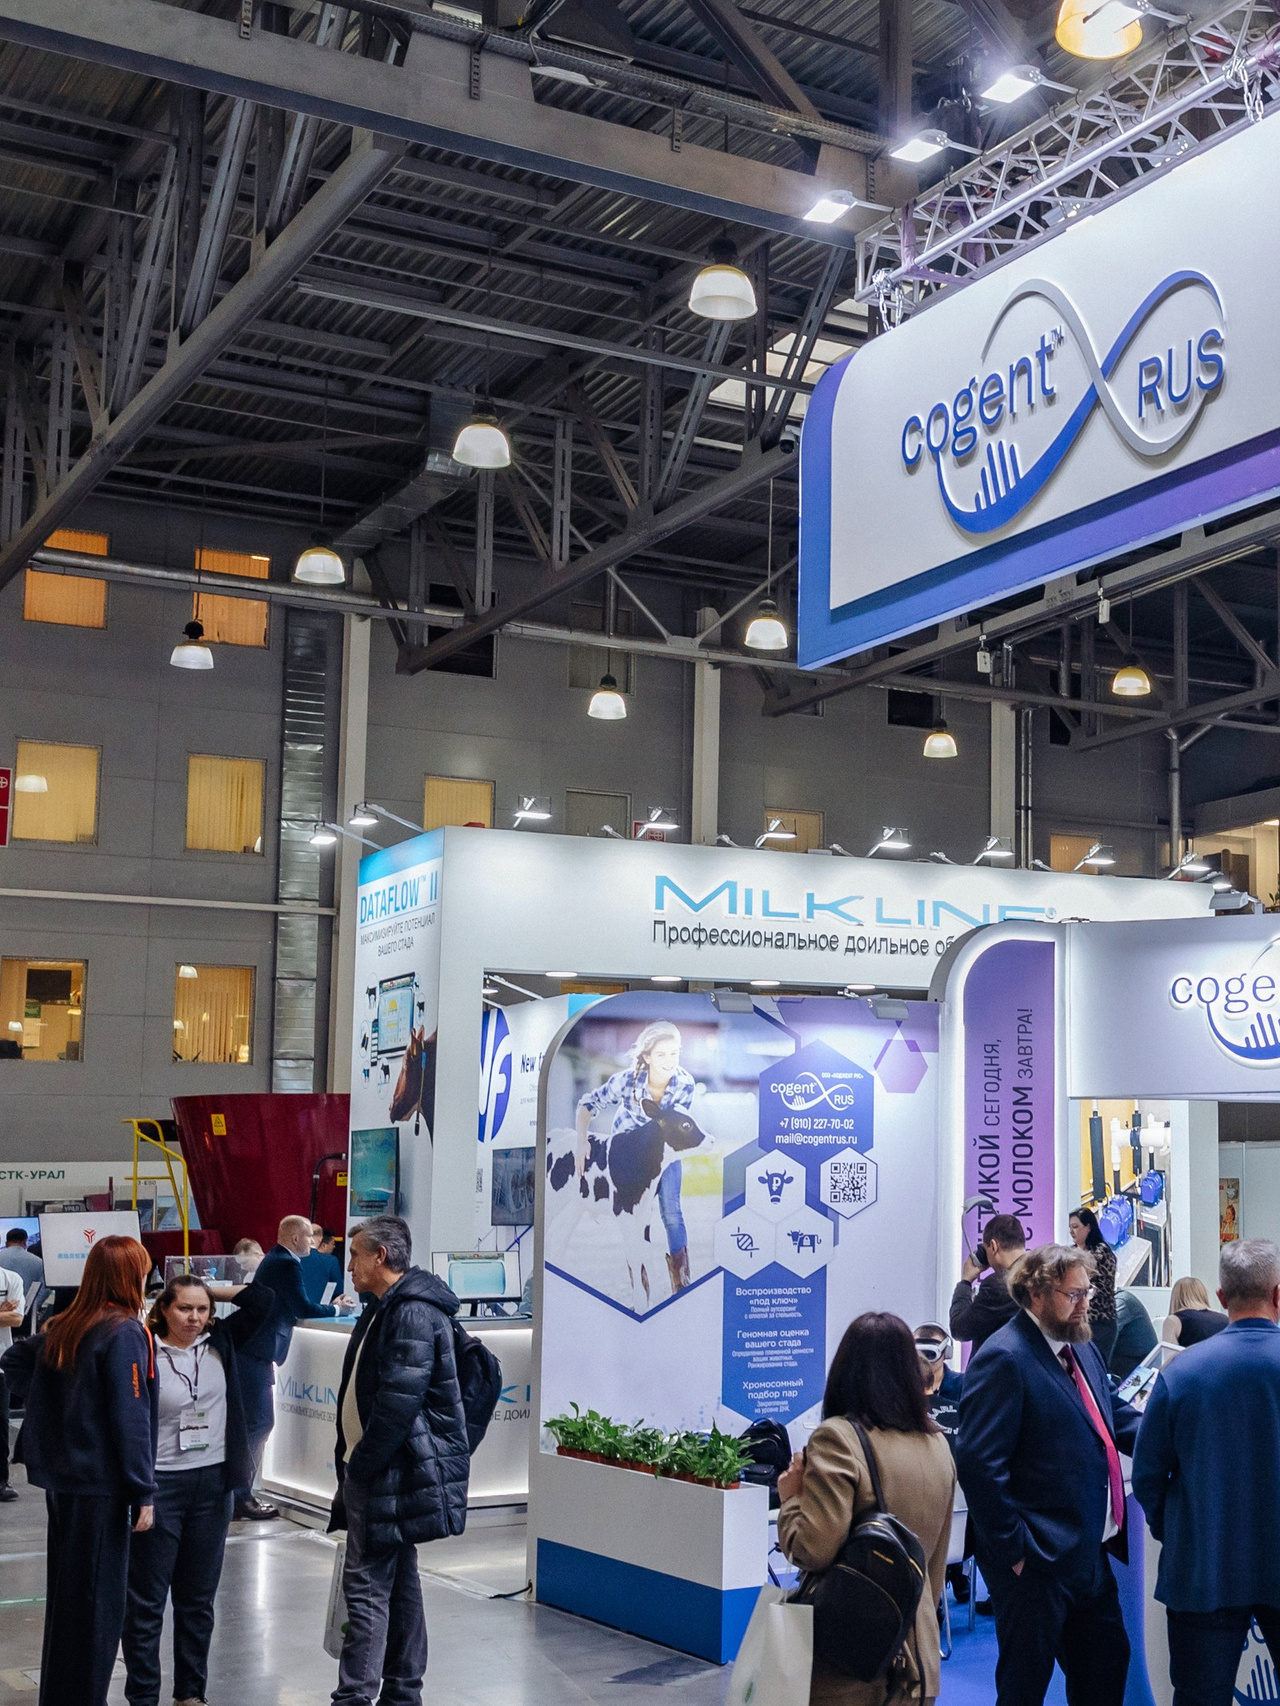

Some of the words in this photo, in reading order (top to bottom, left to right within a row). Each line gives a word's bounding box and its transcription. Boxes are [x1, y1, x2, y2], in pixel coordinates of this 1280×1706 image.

[1138, 329, 1224, 418] RUS
[398, 936, 414, 951] СТАДА
[653, 920, 840, 950] Профессиональное
[844, 935, 930, 957] доильное
[1017, 1007, 1034, 1080] ЗАВТРА!
[984, 1038, 1003, 1126] СЕГОДНЯ,
[834, 1094, 854, 1105] RUS
[780, 1118, 789, 1129] +7
[791, 1117, 811, 1131] (910)
[813, 1118, 855, 1130] 227-70-02
[775, 1132, 858, 1146] mail@cogentrus.ru
[1012, 1086, 1034, 1217] МОЛОКОМ
[973, 1134, 1001, 1242] ТИКОЙ
[735, 1287, 812, 1297] Воспроизводство
[749, 1298, 770, 1307] «под
[772, 1297, 798, 1306] ключ»
[737, 1330, 778, 1339] Геномная
[779, 1328, 810, 1338] оценка
[745, 1340, 777, 1349] вашего
[778, 1339, 802, 1348] стада
[278, 1374, 338, 1406] MILKLIN
[742, 1378, 804, 1390] Хромосомный
[747, 1390, 780, 1400] подбор
[782, 1389, 798, 1399] пар
